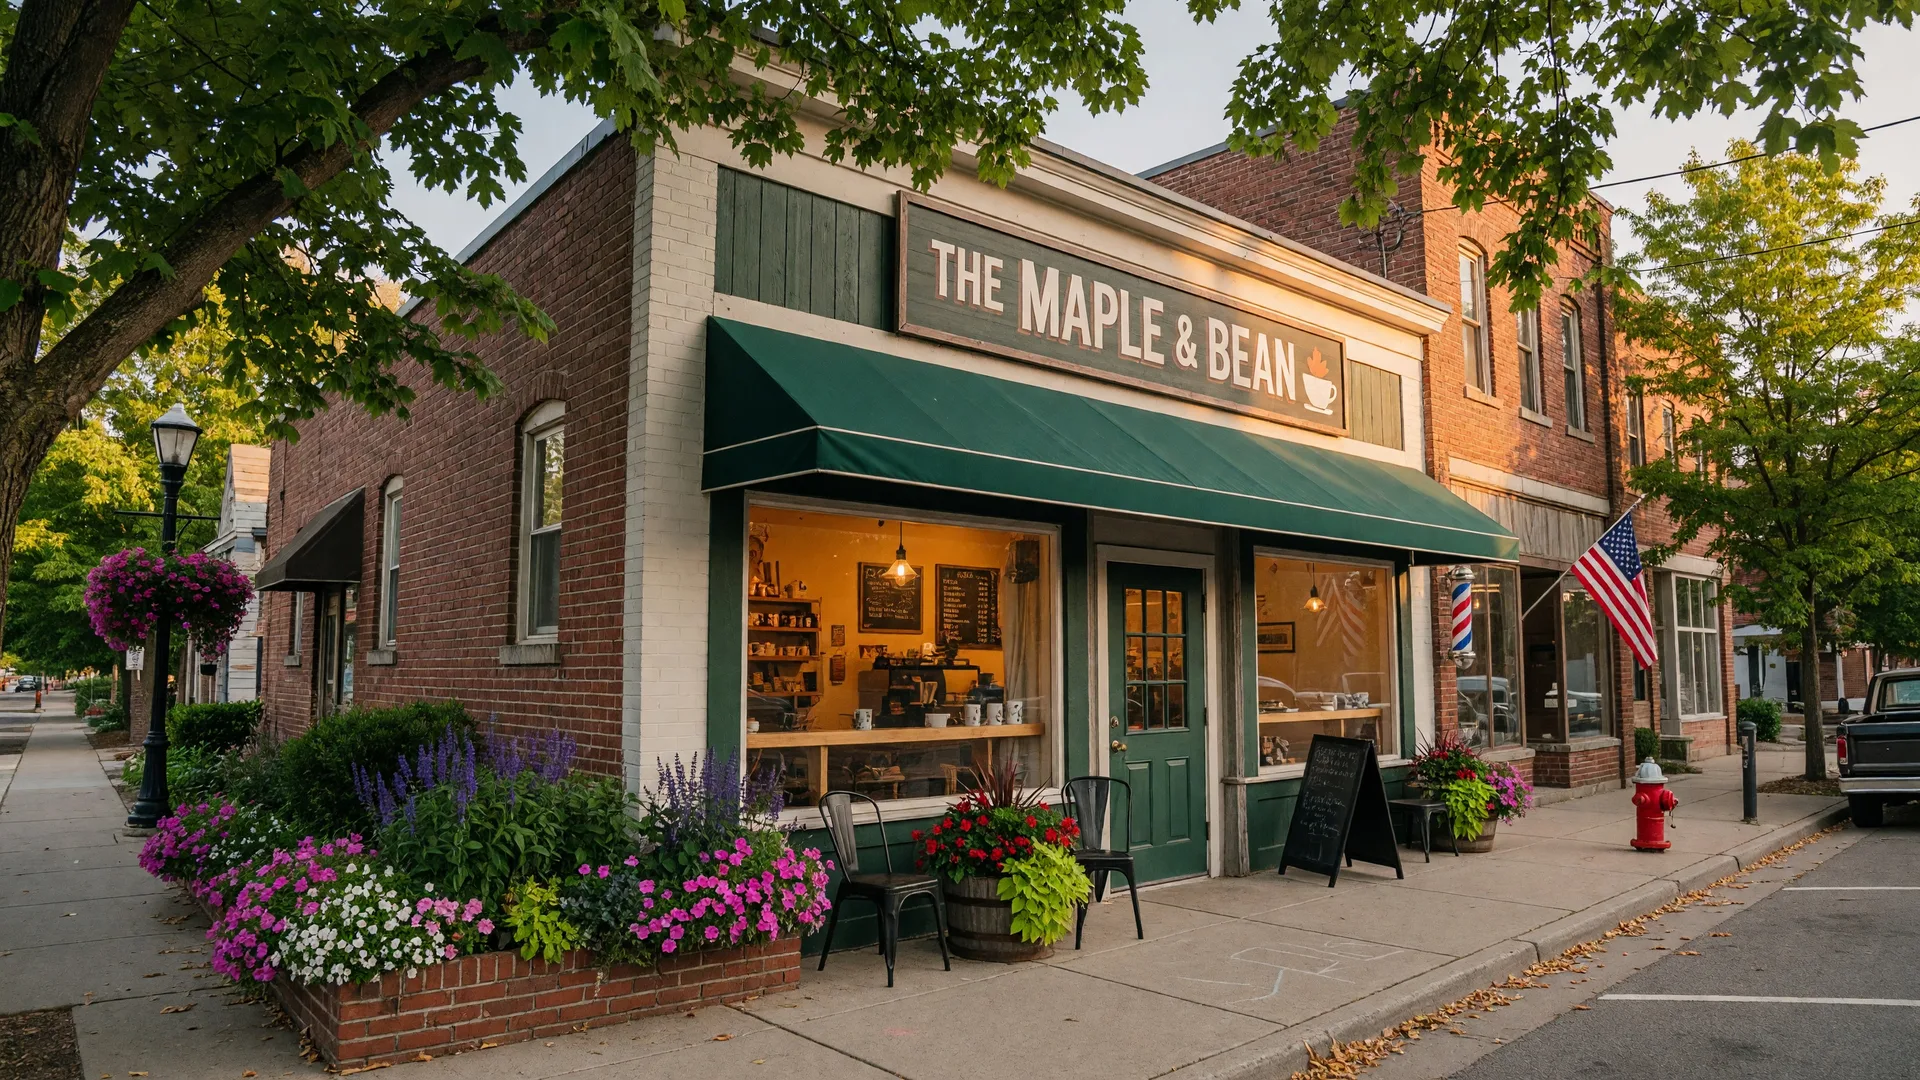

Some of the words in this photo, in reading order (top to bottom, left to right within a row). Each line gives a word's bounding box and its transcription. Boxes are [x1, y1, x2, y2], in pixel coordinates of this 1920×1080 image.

[930, 238, 1004, 313] THE
[1020, 258, 1165, 366] MAPLE
[1174, 314, 1198, 369] &
[1206, 316, 1297, 401] BEAN
